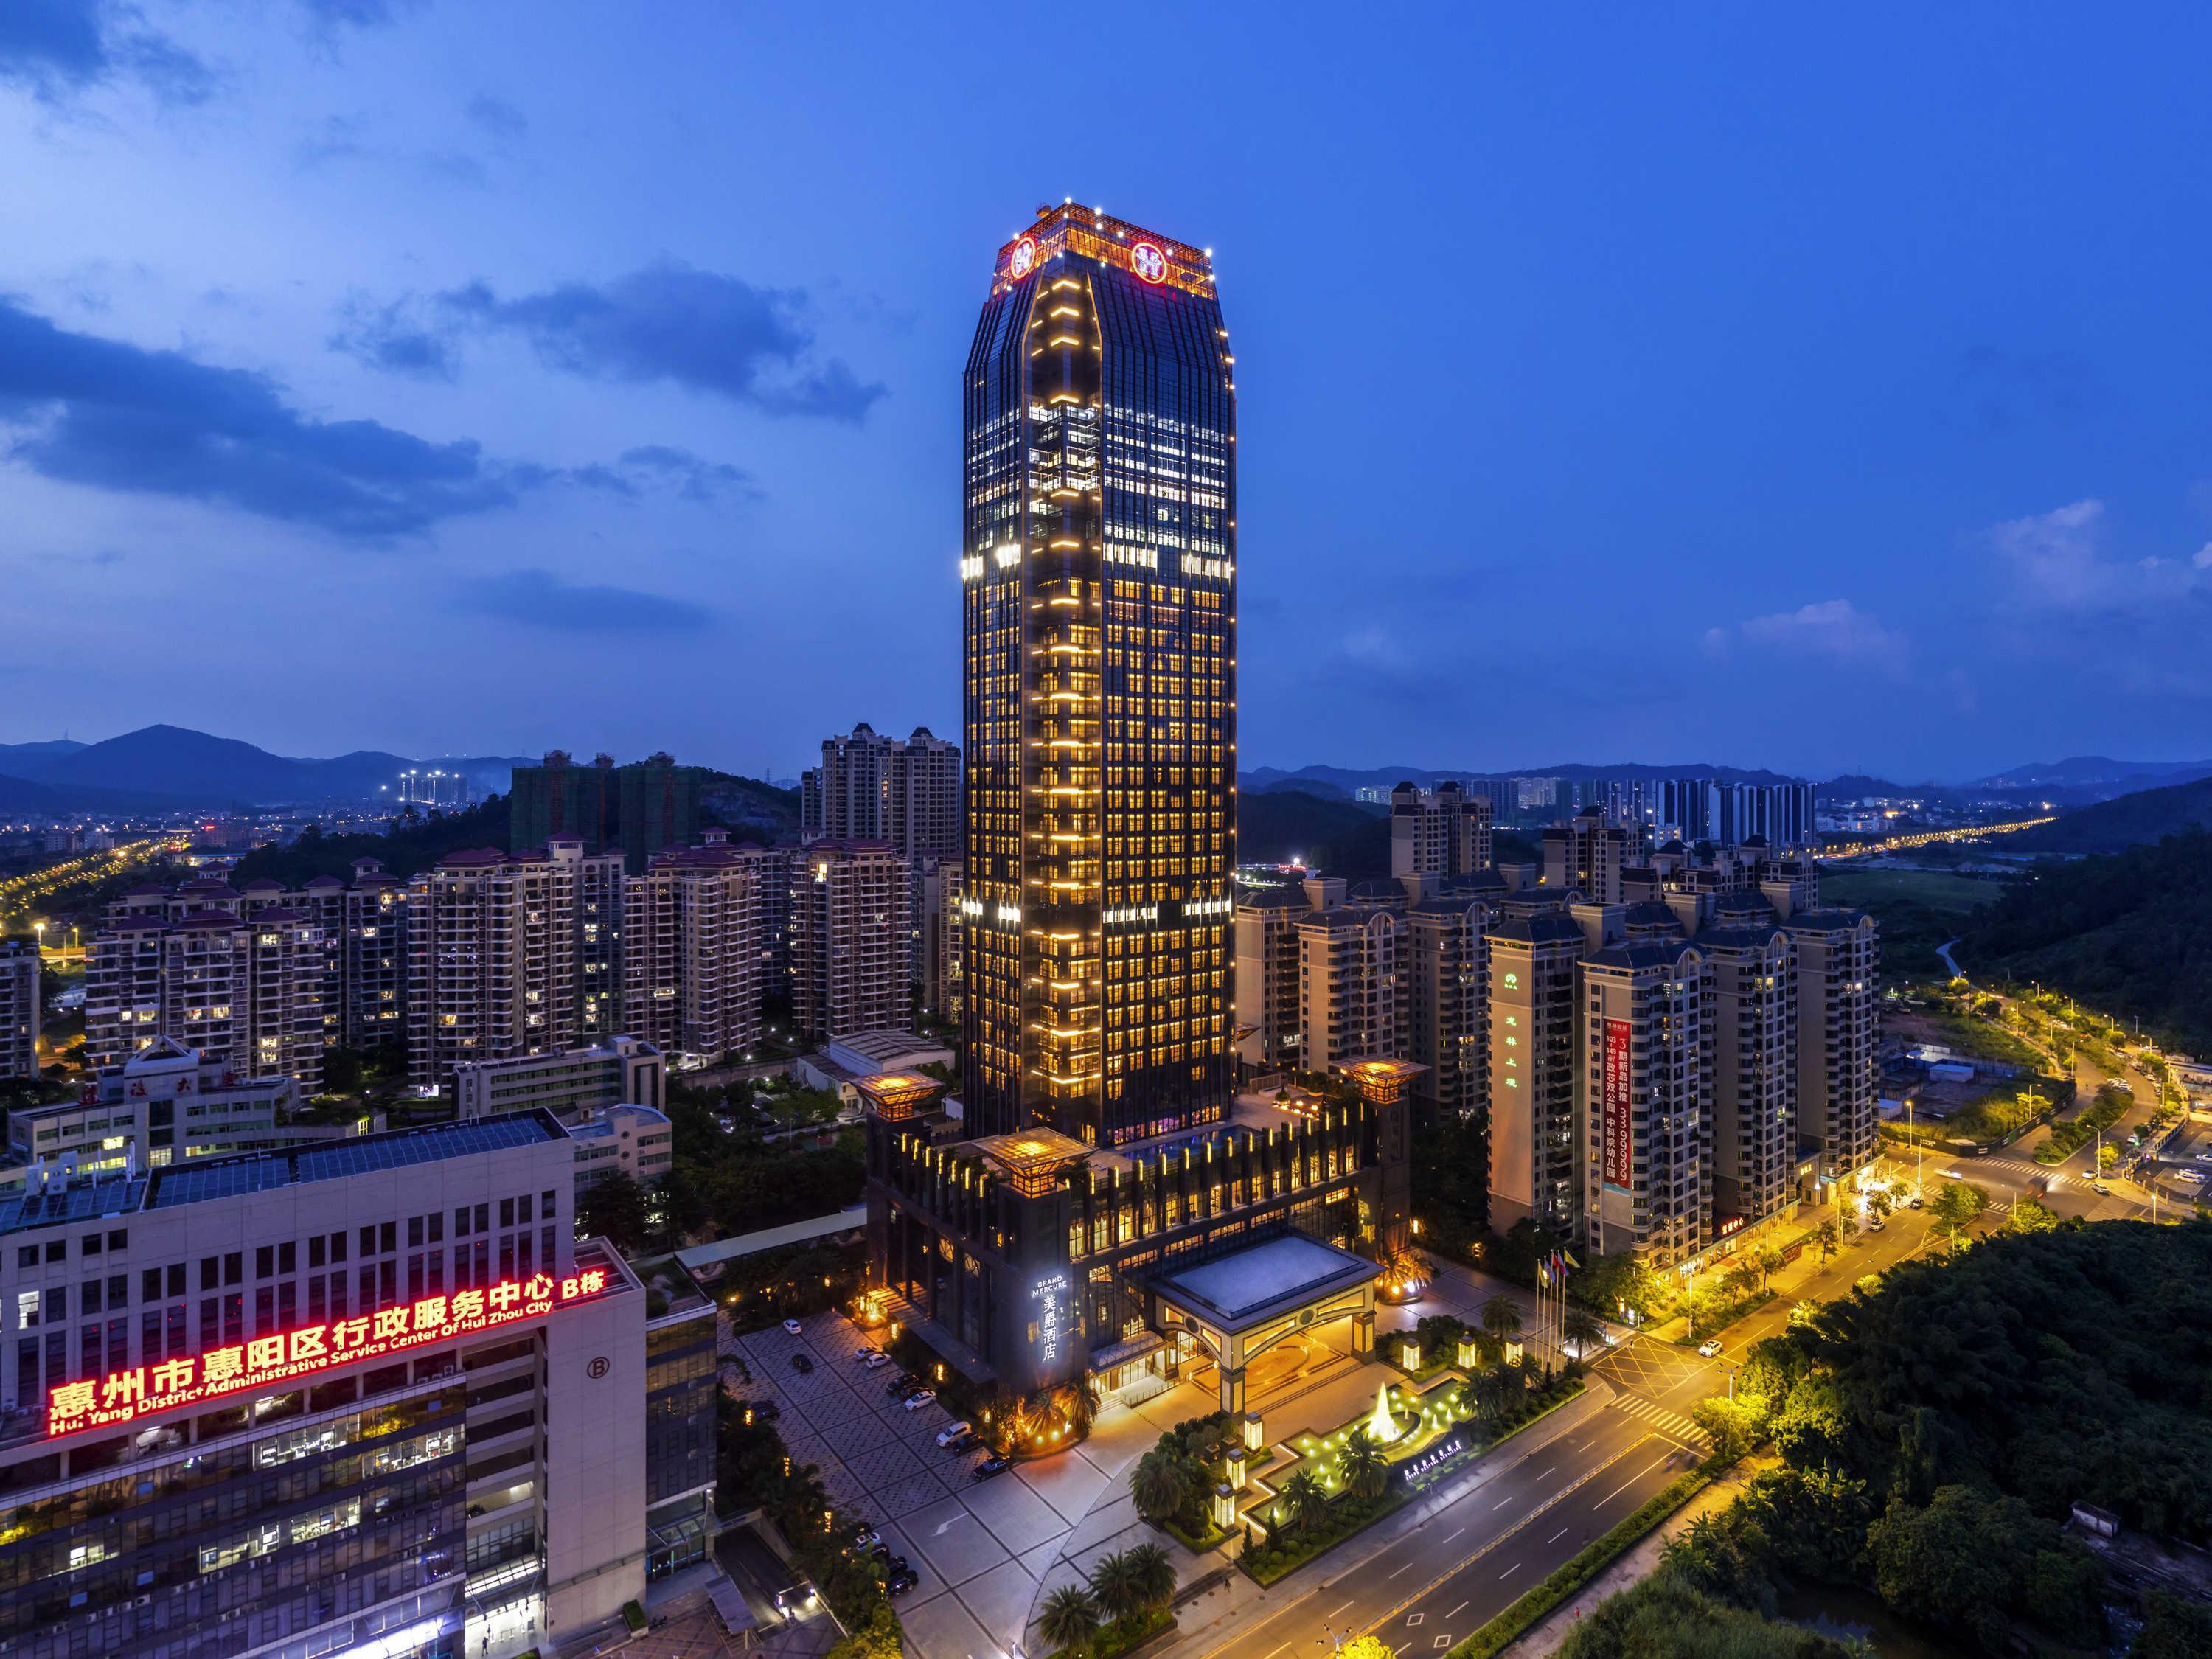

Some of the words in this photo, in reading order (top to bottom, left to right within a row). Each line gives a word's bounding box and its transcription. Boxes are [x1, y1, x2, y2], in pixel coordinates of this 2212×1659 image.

[1032, 1280, 1067, 1298] MERCURE
[1038, 1276, 1062, 1288] GRAND
[50, 1273, 554, 1420] 惠州市惠阳区行政服务中心
[562, 1270, 605, 1299] B栋
[88, 1405, 133, 1422] Yang
[138, 1386, 203, 1413] District
[205, 1357, 327, 1396] Administrative
[331, 1341, 386, 1364] Service
[390, 1327, 438, 1349] Center
[441, 1320, 460, 1336] Of
[462, 1315, 486, 1332] Hui
[488, 1308, 524, 1324] Zhou
[526, 1300, 553, 1315] City
[1043, 1295, 1057, 1362] 美爵酒店
